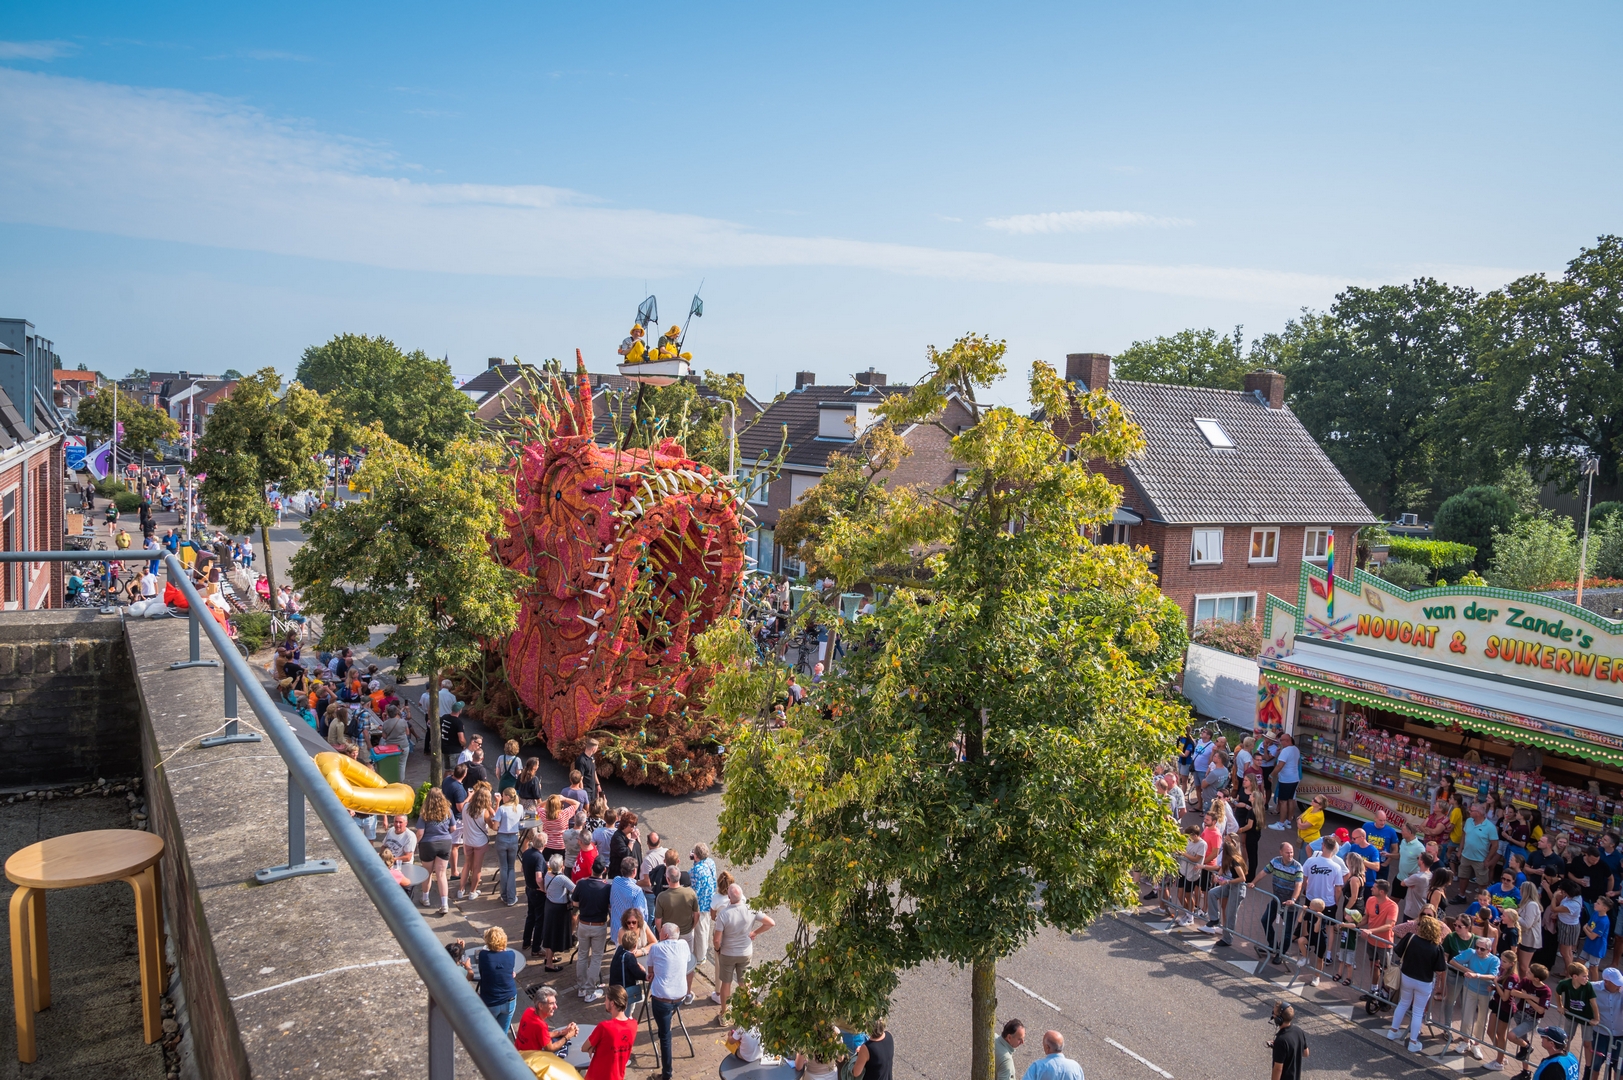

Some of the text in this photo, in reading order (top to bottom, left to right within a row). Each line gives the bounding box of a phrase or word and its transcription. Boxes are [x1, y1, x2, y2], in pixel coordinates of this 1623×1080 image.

[1356, 614, 1440, 648] NOUGAT
[1449, 630, 1467, 654] &
[1422, 601, 1594, 649] van der Zande's
